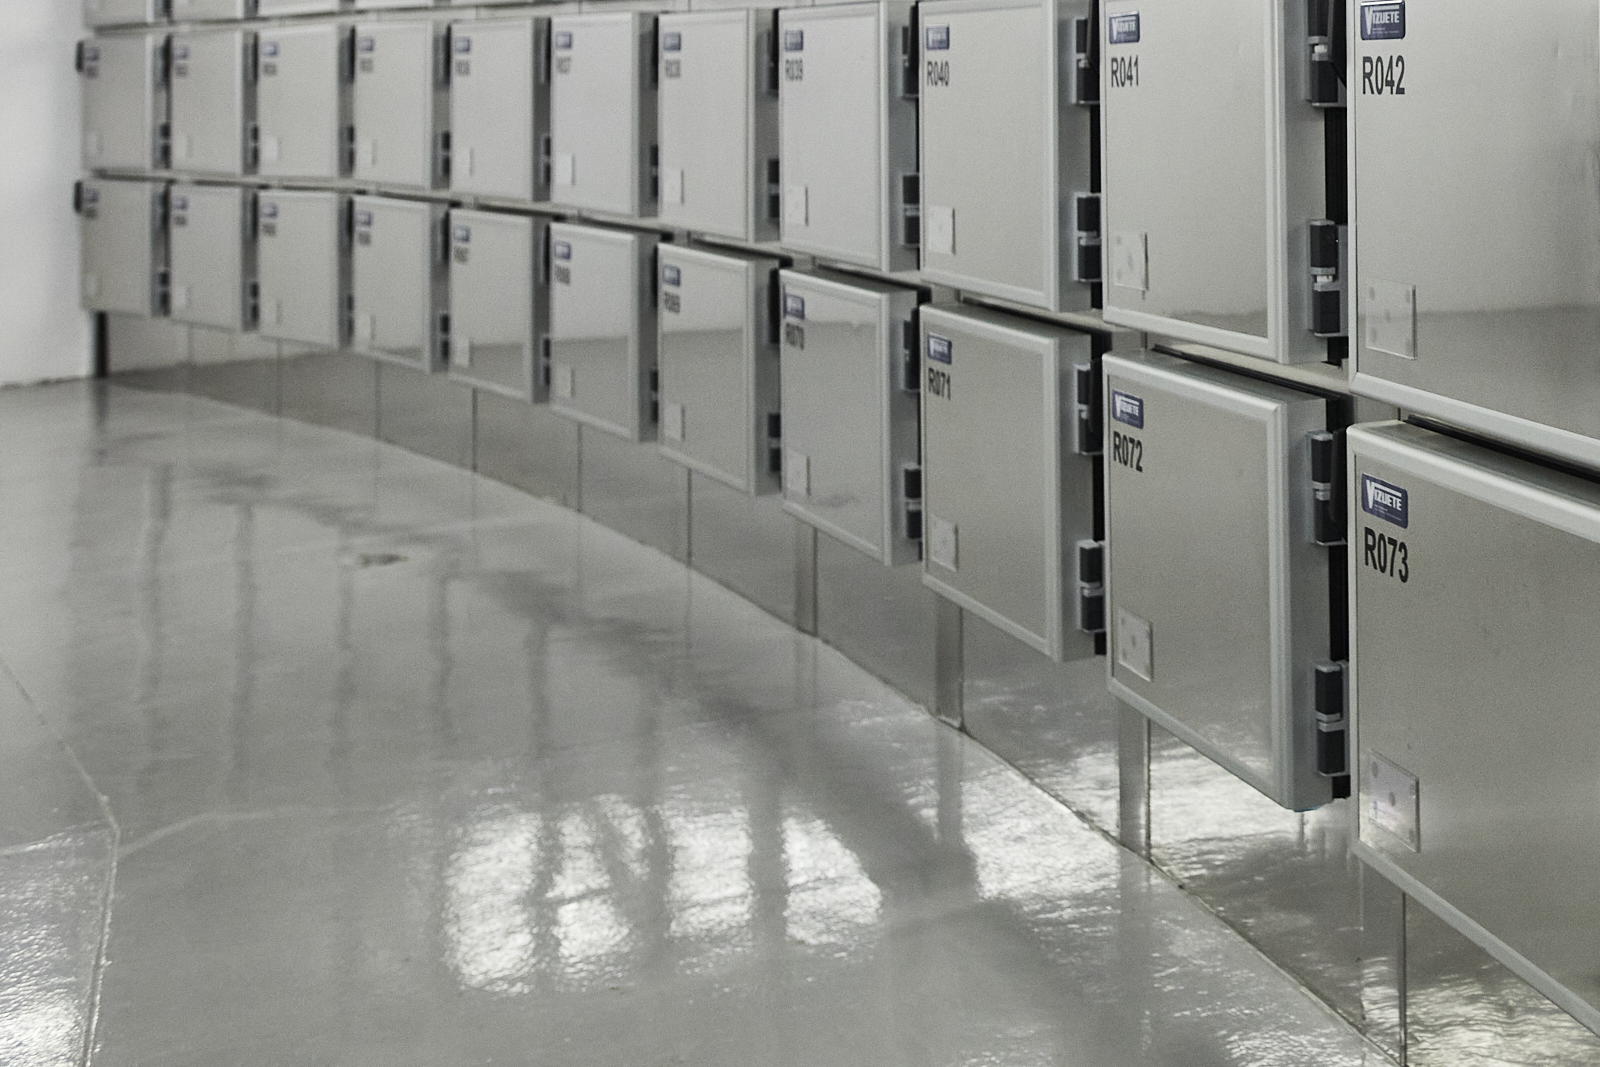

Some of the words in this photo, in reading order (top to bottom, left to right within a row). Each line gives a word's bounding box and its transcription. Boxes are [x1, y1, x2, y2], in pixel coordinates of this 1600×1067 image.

[1364, 5, 1400, 36] VIZUETE
[926, 60, 950, 86] R040
[1111, 55, 1139, 88] R041
[1362, 55, 1406, 95] R042
[1113, 430, 1143, 473] R072
[1366, 479, 1402, 511] VIZUETE
[1364, 526, 1409, 584] R073
